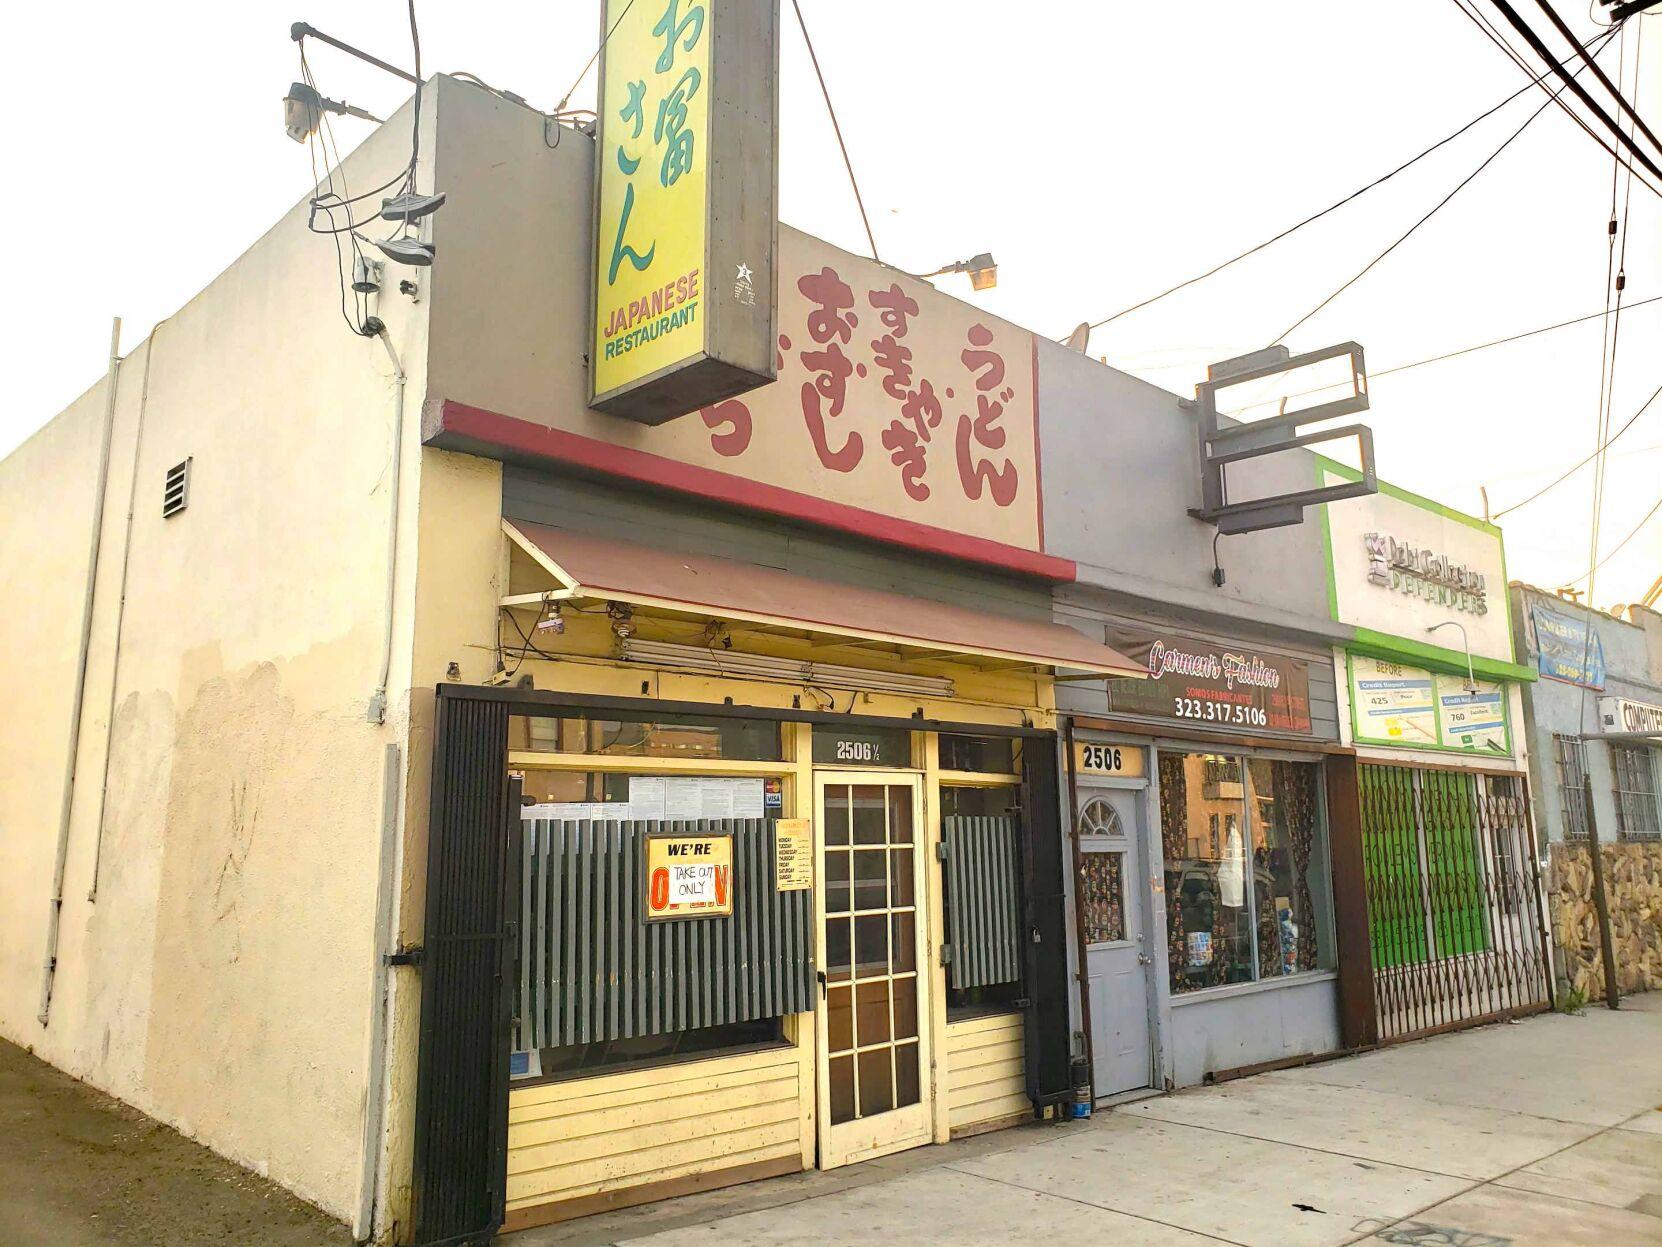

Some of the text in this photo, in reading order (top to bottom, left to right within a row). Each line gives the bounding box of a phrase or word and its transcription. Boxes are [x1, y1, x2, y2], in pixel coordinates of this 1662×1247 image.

[603, 269, 699, 338] JAPANESE
[605, 301, 698, 361] RESTAURANT
[868, 283, 954, 502] すきやき
[955, 323, 1018, 506] うどん
[1389, 569, 1488, 616] DEFENDERS
[1149, 640, 1280, 690] Carmen's Fashion
[1375, 661, 1402, 677] BEFORE
[1174, 697, 1267, 726] 323.317.5106
[1450, 711, 1465, 722] 760
[837, 741, 871, 760] 2506
[1083, 745, 1122, 771] 2506
[767, 794, 780, 802] VISA
[668, 843, 712, 856] WE'RE
[674, 866, 713, 880] TAKE OUT
[678, 881, 706, 896] ONLY
